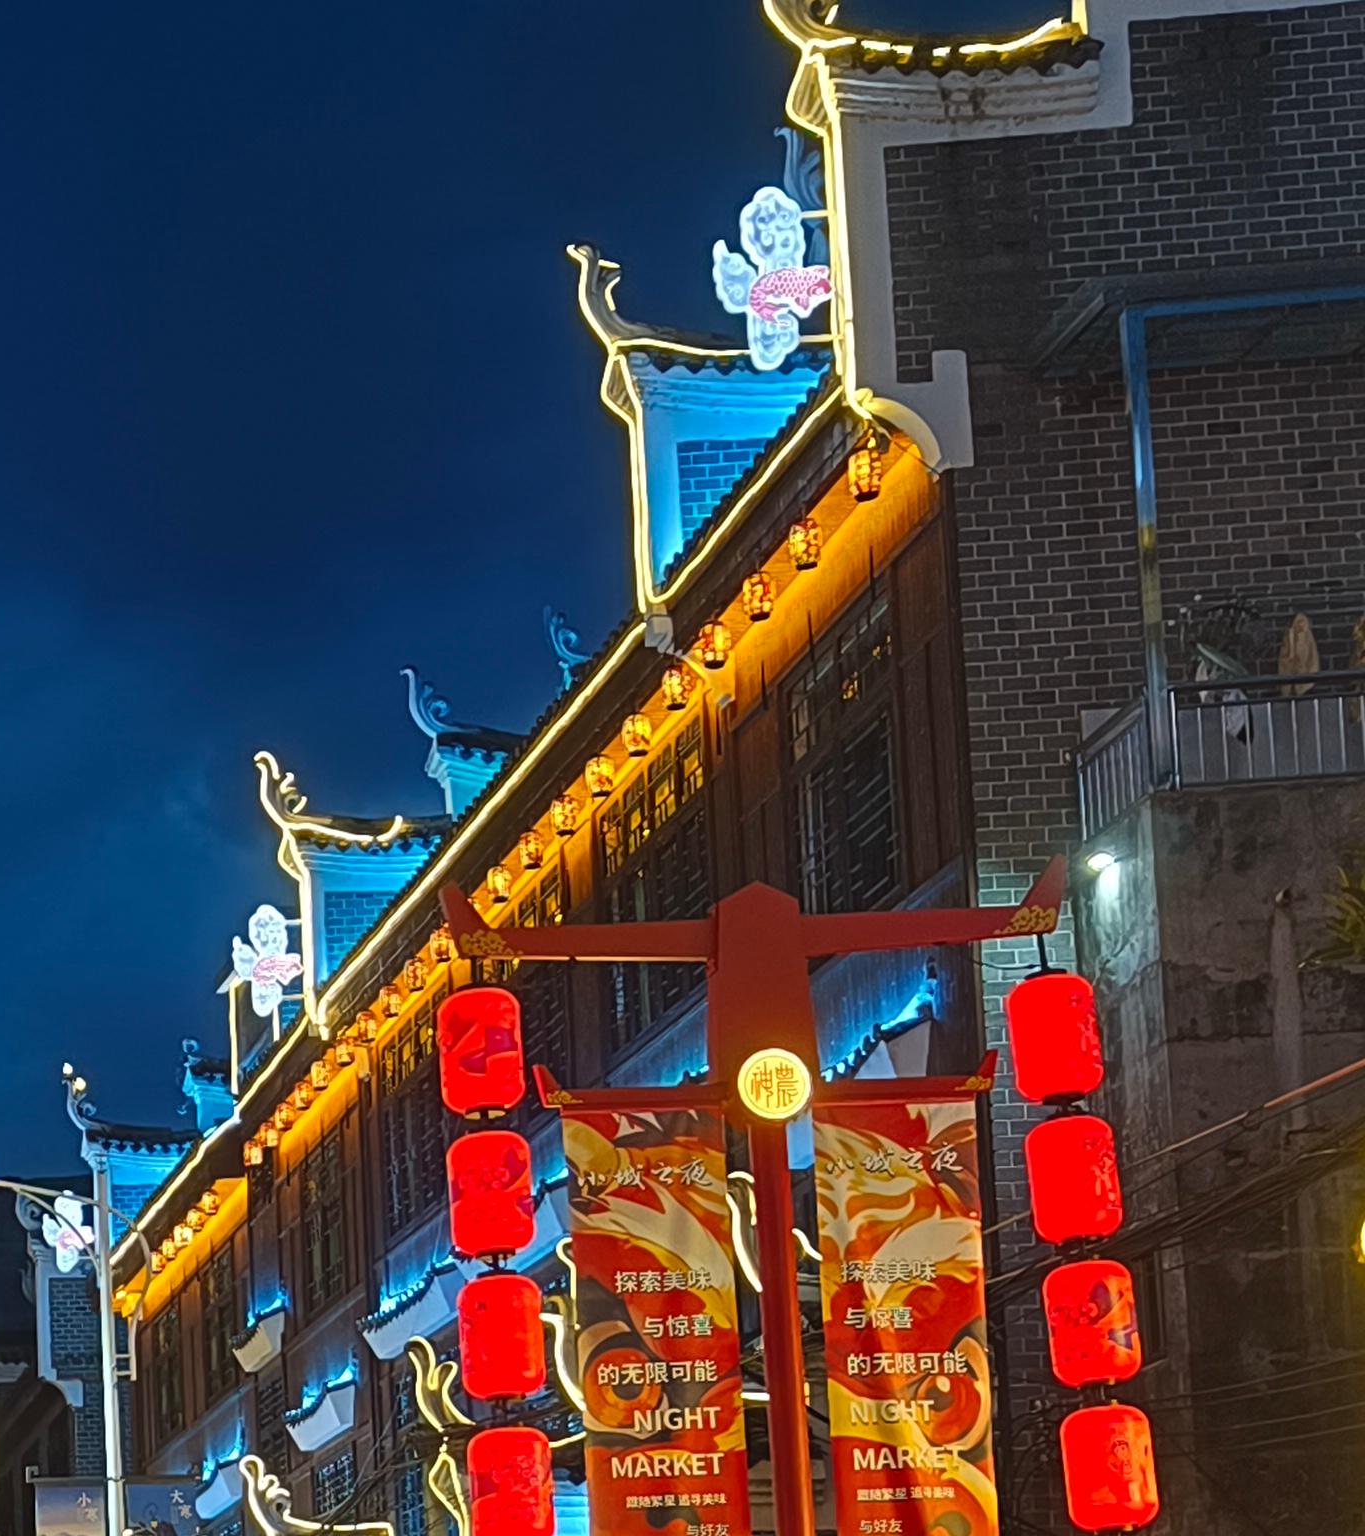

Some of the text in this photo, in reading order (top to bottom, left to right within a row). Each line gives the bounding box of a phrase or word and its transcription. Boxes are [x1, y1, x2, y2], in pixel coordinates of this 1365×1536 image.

[614, 1268, 713, 1293] 探索美味
[841, 1257, 937, 1283] 探索美味
[642, 1315, 713, 1339] 与惊喜
[844, 1307, 913, 1330] 与惊喜
[597, 1359, 718, 1386] 的无限可能
[847, 1352, 968, 1377] 的无限可能
[633, 1406, 721, 1433] NIGHT
[849, 1400, 935, 1426] NIGHT
[611, 1453, 725, 1479] MARKET
[853, 1446, 968, 1472] MARKET
[859, 1518, 903, 1534] 与好友
